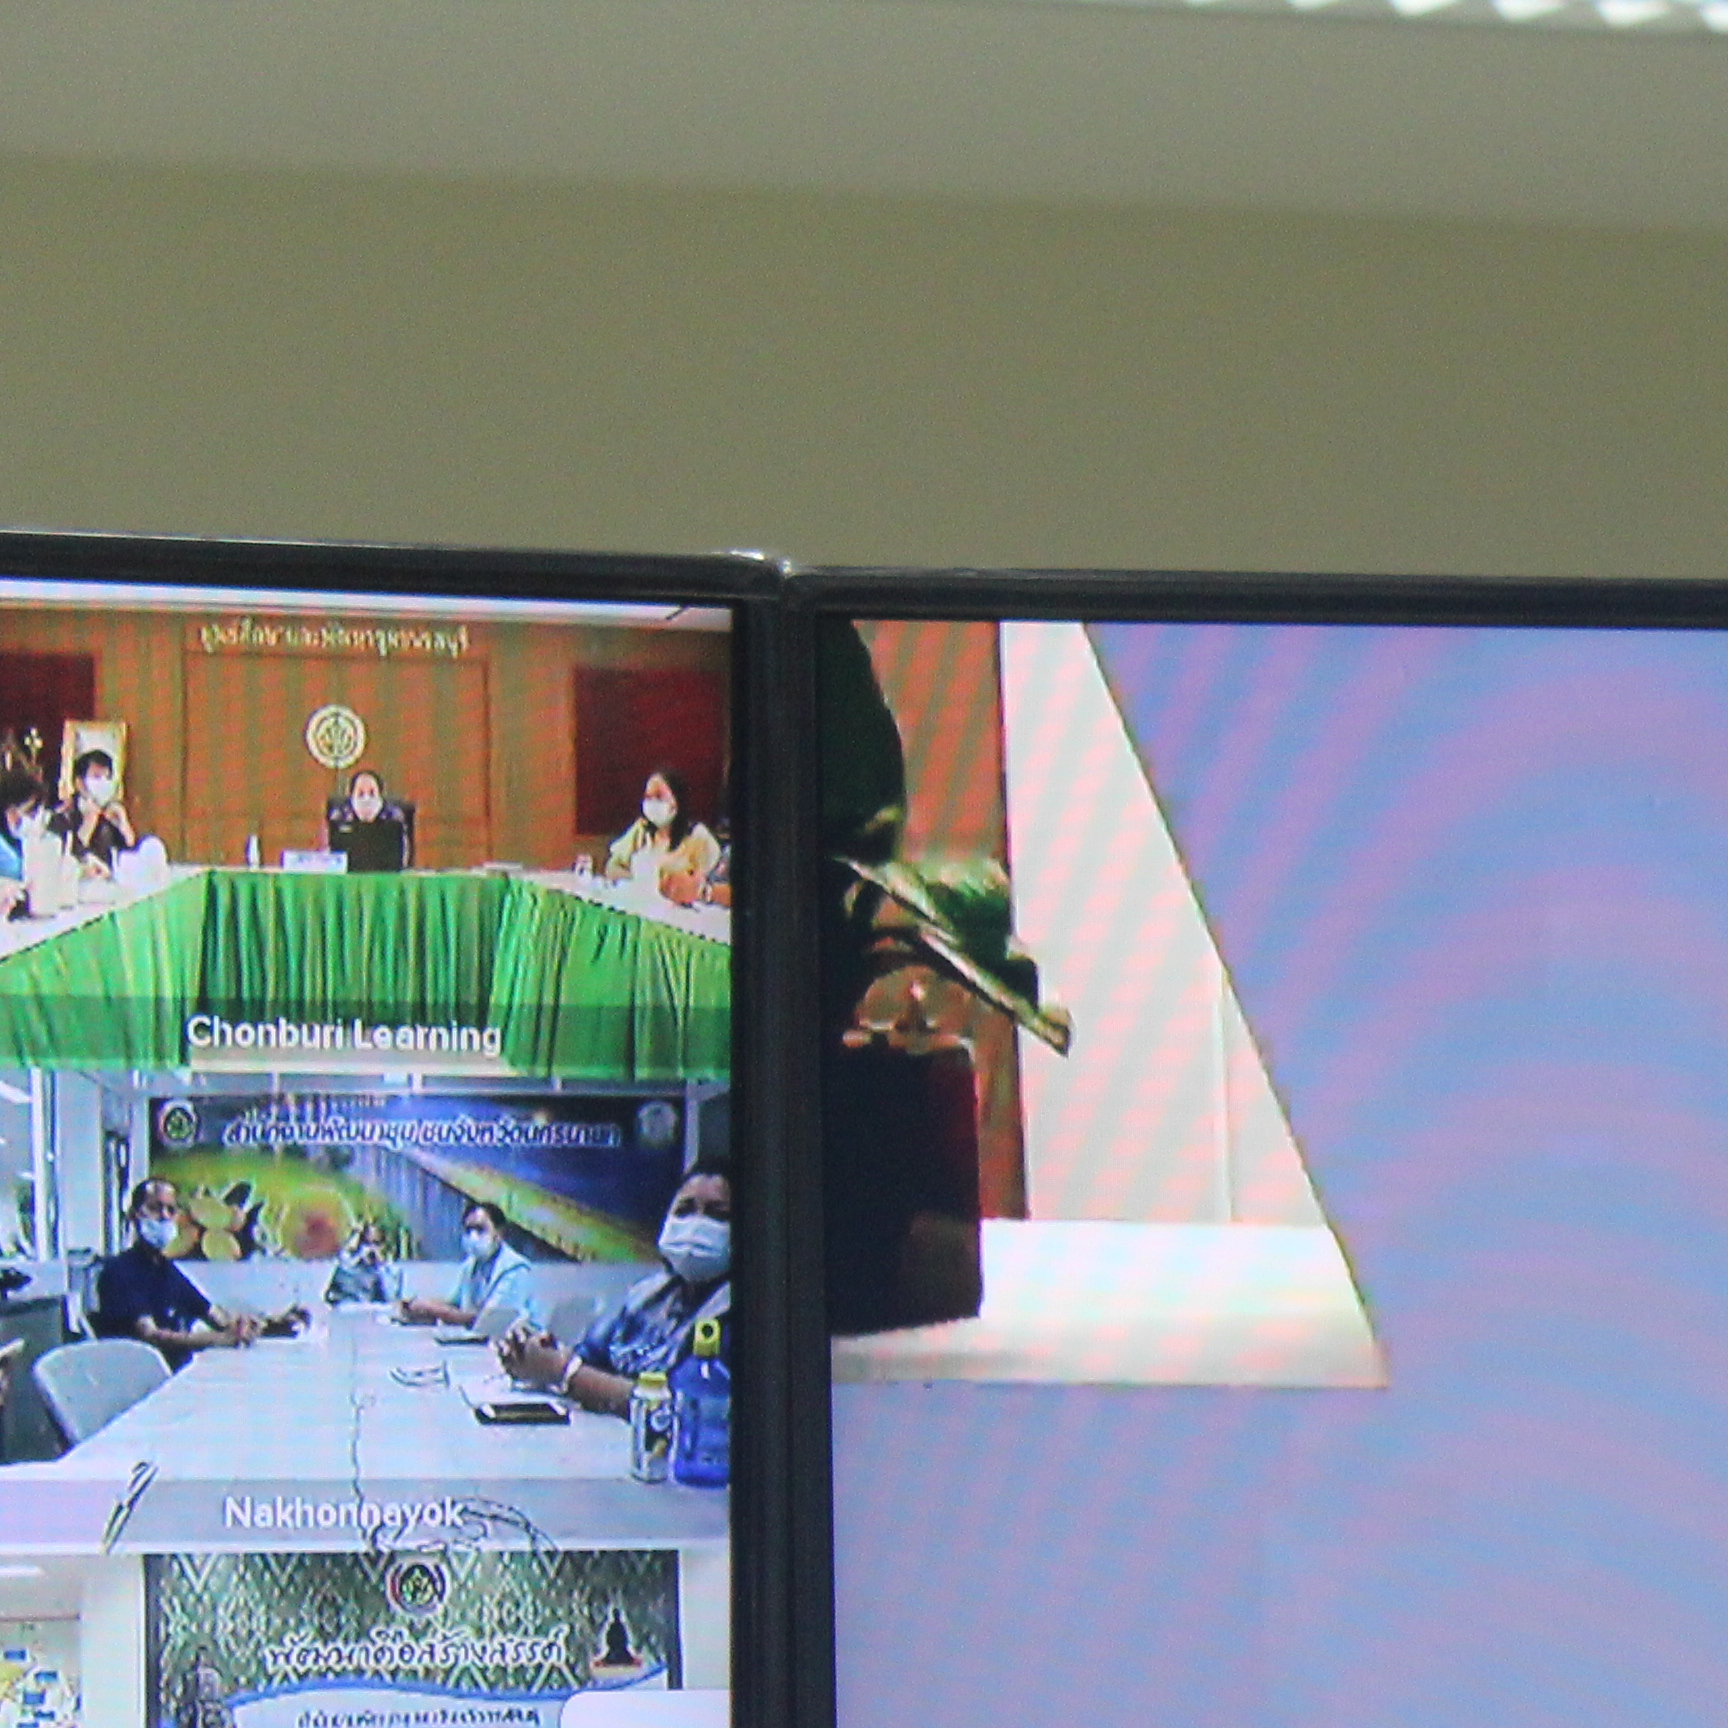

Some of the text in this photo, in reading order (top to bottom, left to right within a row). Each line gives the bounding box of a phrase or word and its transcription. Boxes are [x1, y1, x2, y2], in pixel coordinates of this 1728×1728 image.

[186, 1014, 501, 1058] Chonburi Learning
[225, 1496, 465, 1540] Nakhonnayok
